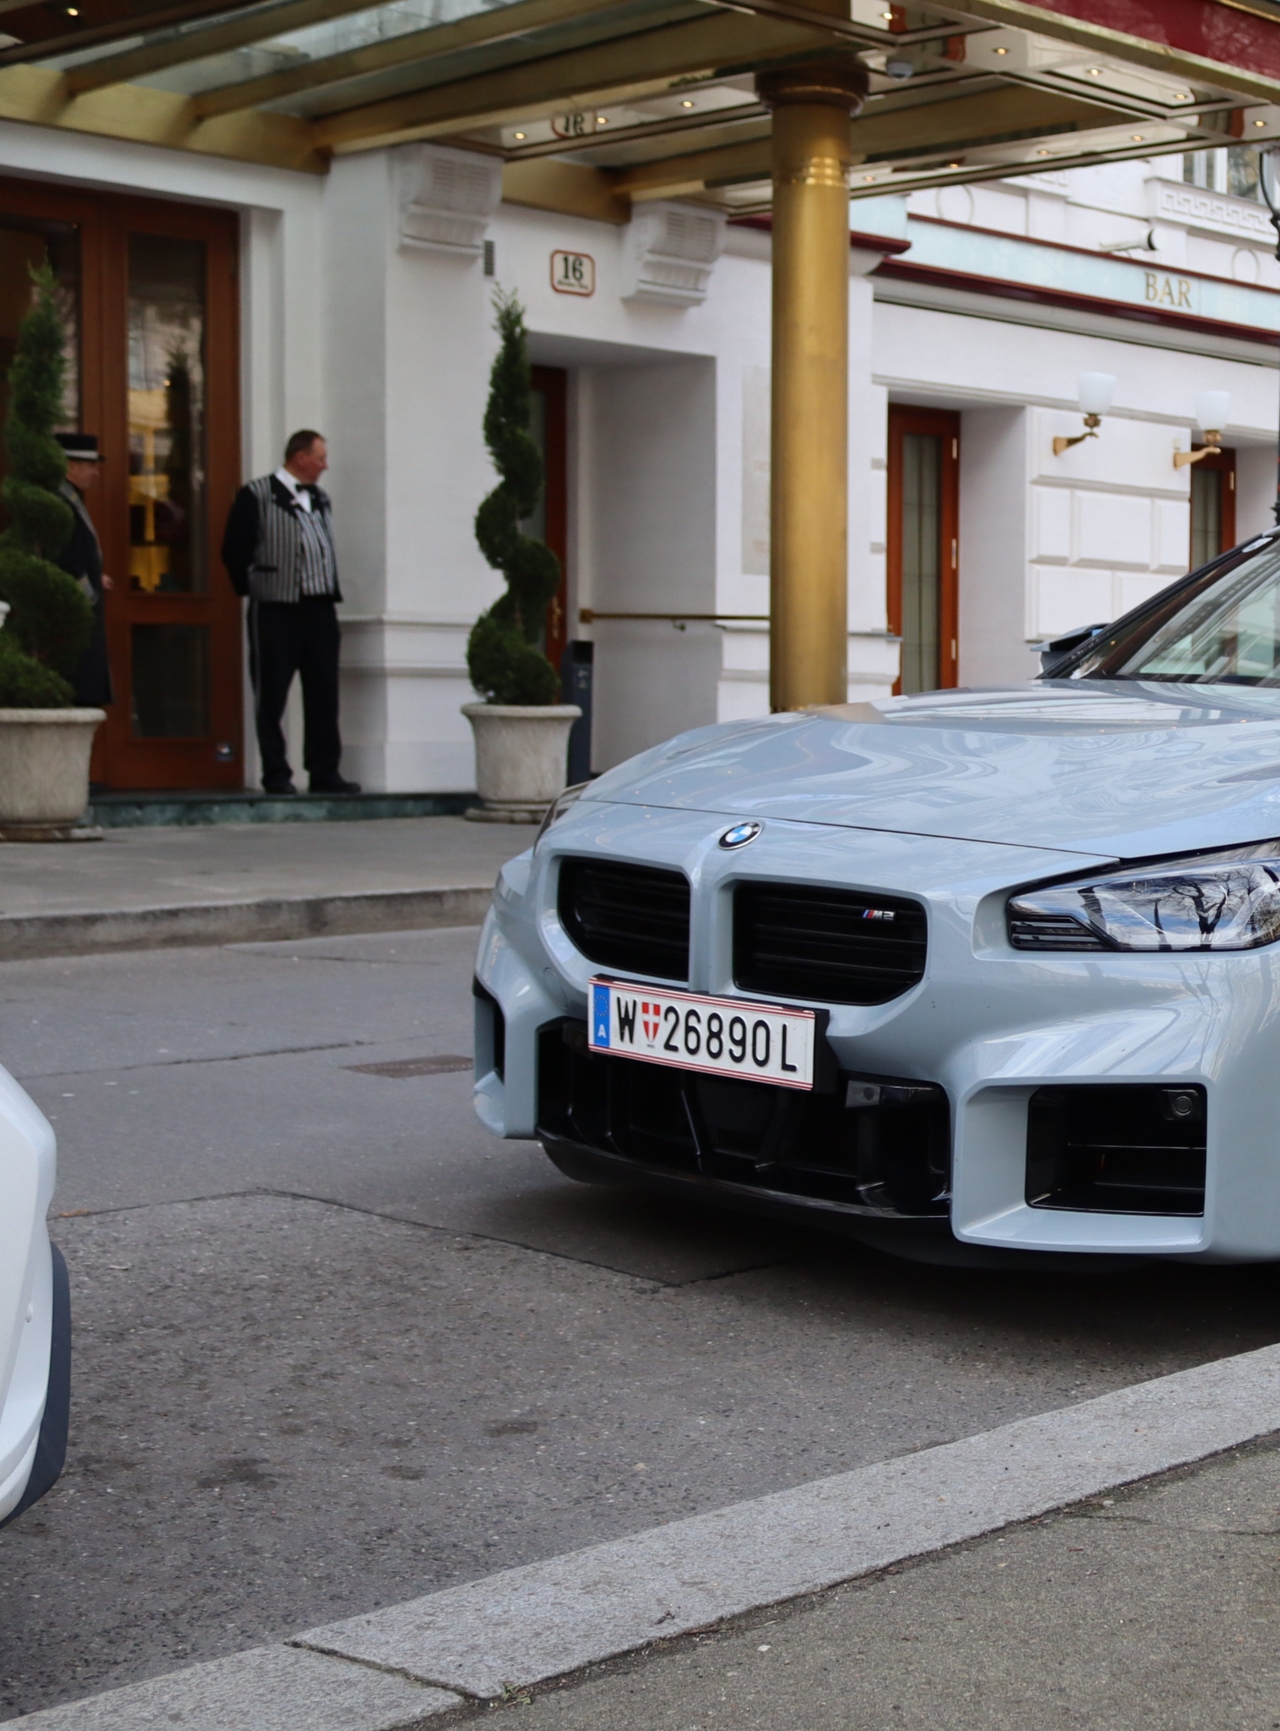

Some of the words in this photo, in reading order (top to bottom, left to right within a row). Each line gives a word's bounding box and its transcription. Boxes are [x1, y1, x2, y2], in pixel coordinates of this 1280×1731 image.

[562, 256, 584, 281] 16
[1144, 271, 1192, 308] BAR
[597, 1024, 607, 1039] A
[616, 996, 637, 1044] W
